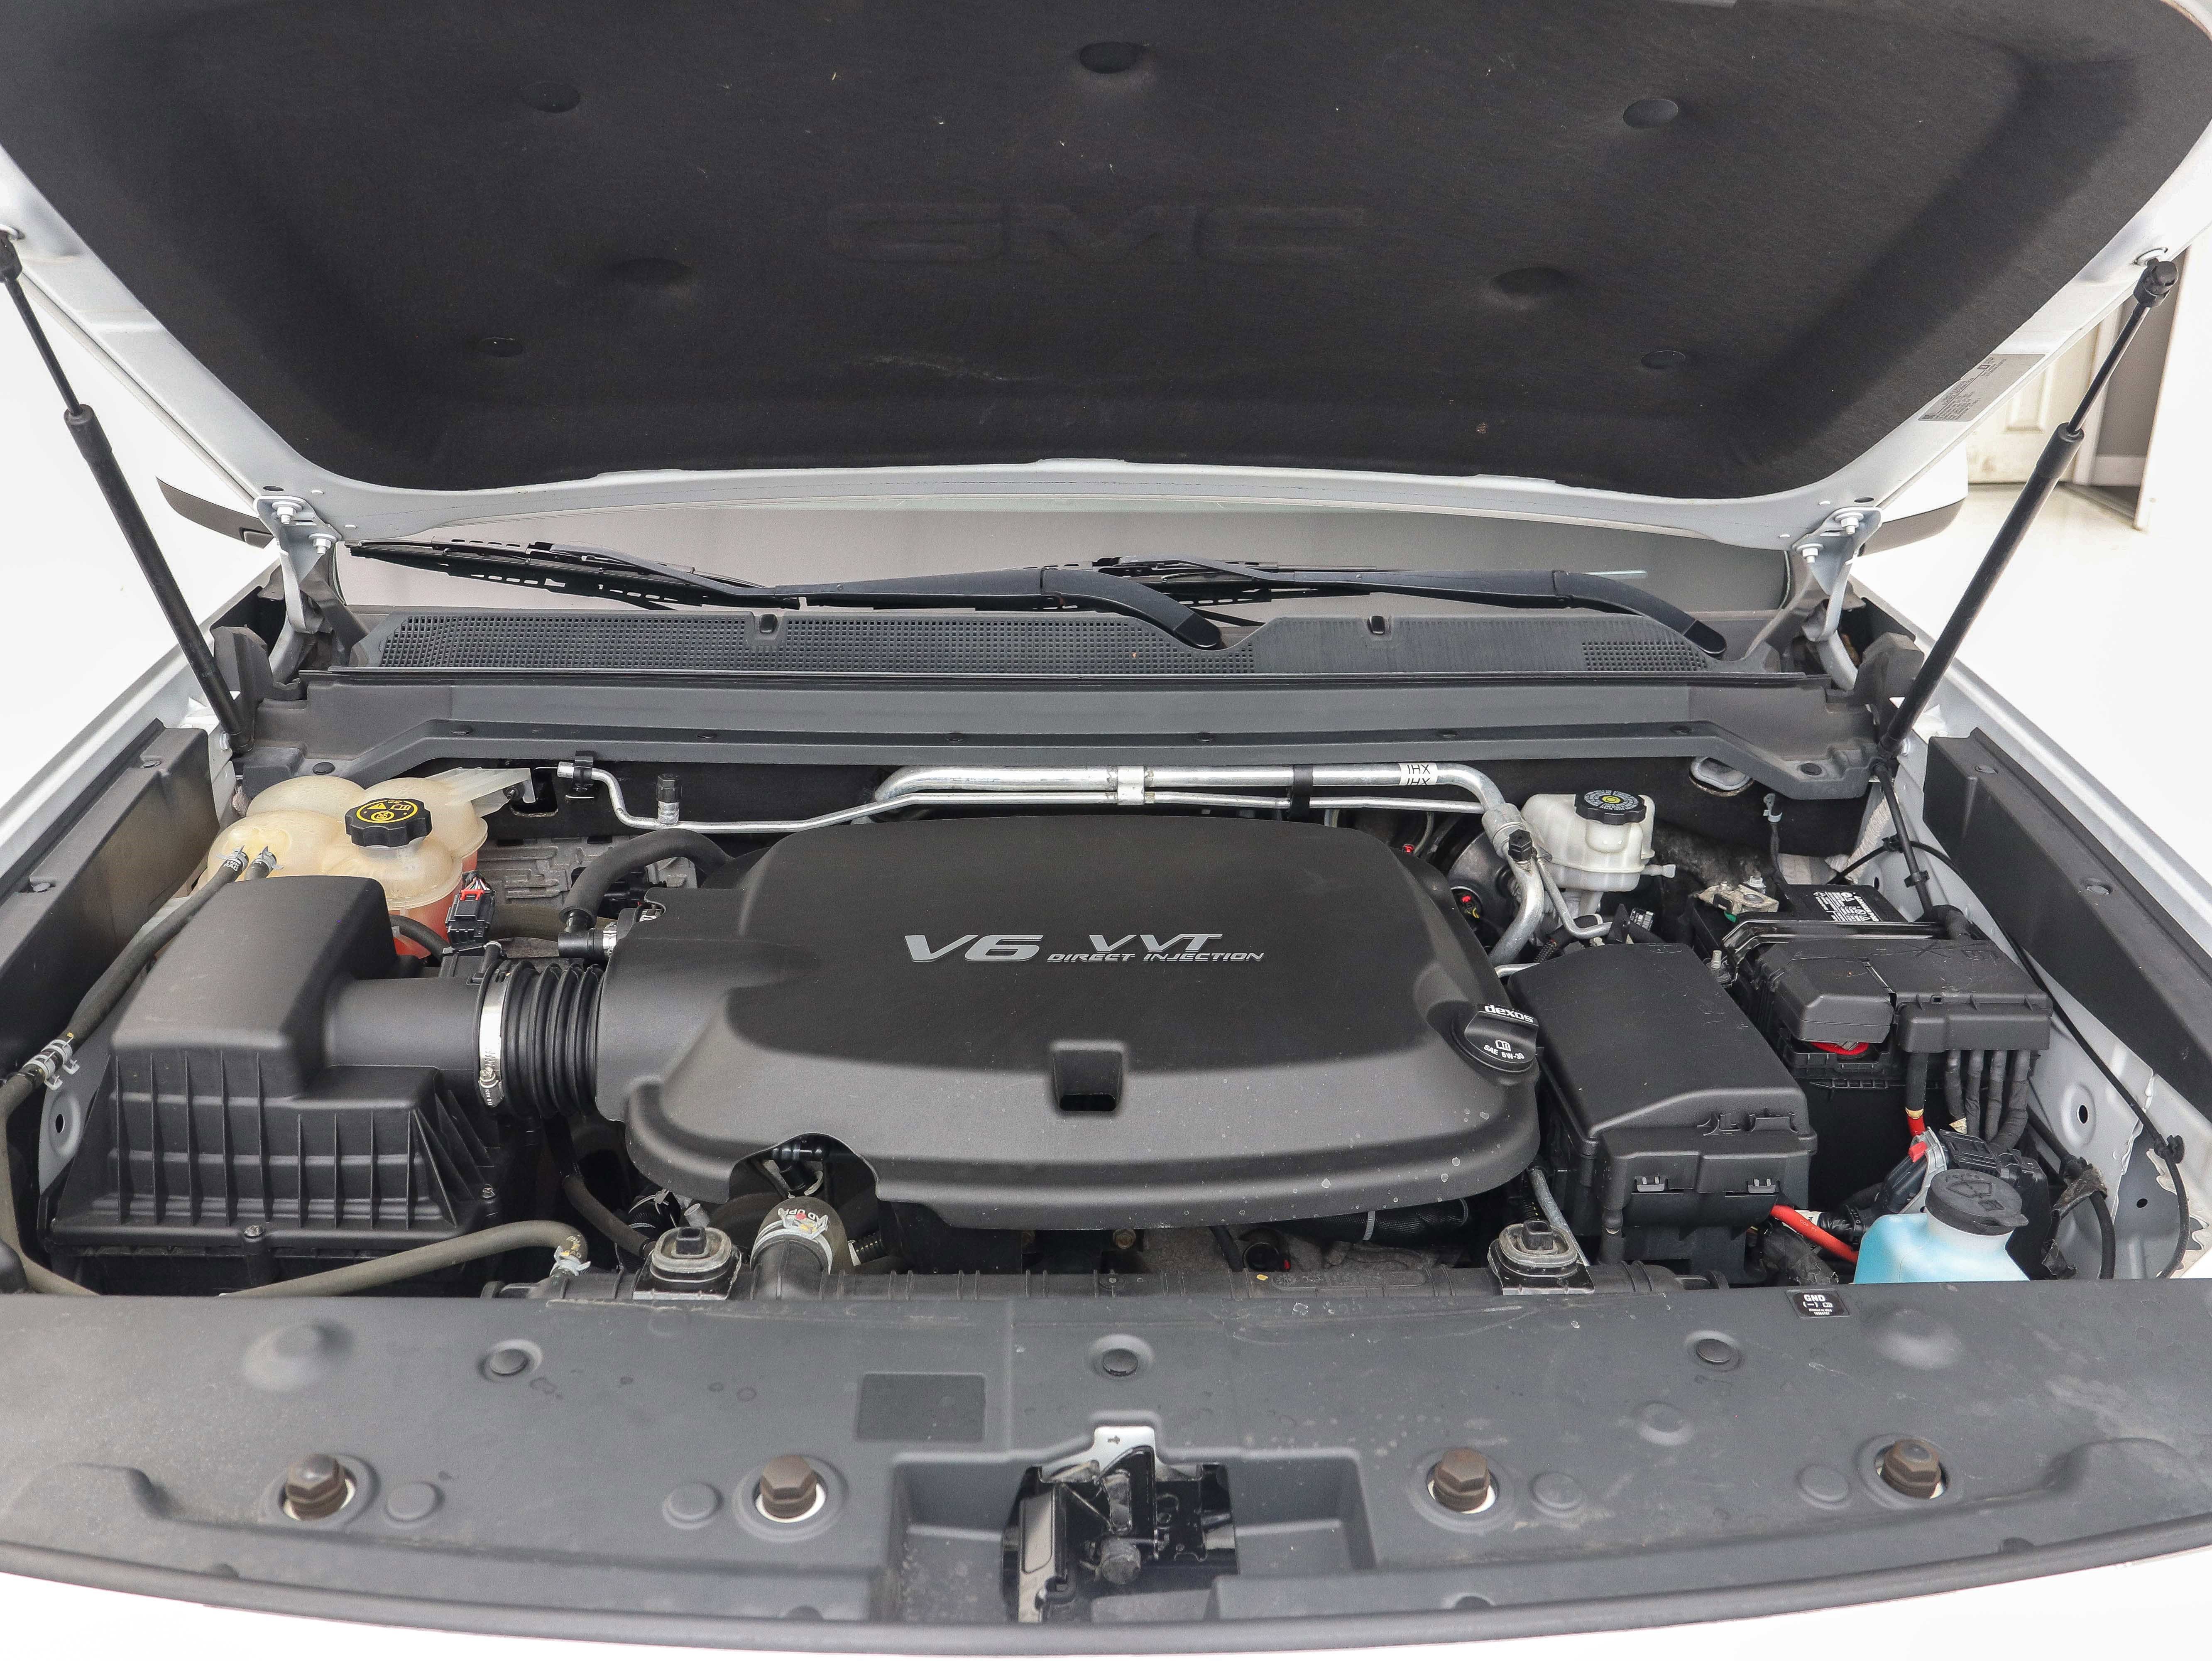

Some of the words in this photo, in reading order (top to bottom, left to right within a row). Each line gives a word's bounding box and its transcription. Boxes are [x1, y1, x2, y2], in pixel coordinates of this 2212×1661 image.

[904, 934, 1044, 962] V6
[1089, 933, 1223, 953] VVT
[1046, 953, 1136, 962] DIRECT
[1143, 952, 1265, 962] INJECTION
[1484, 1004, 1534, 1023] dexos
[1483, 1044, 1499, 1056] SAE
[1501, 1051, 1525, 1060] 5W-30
